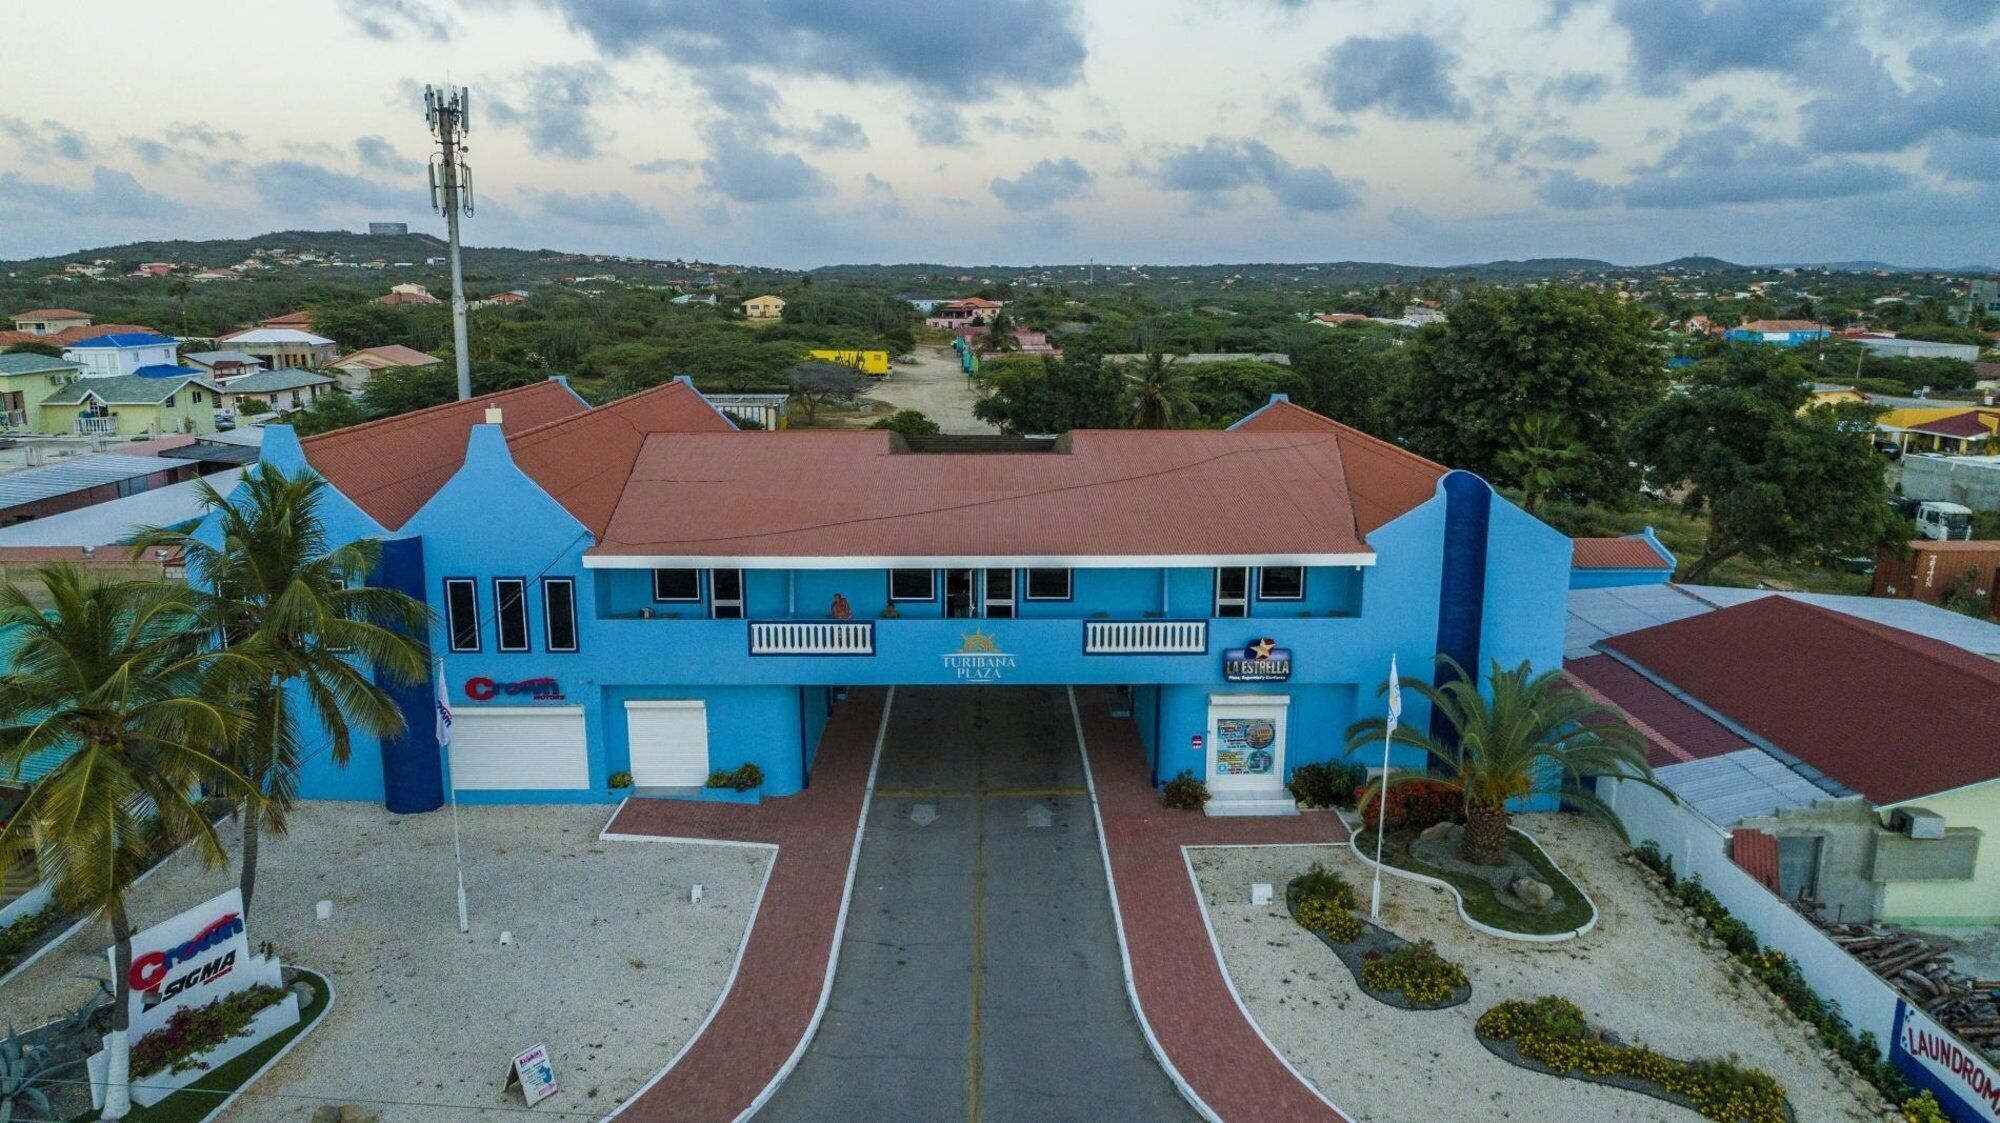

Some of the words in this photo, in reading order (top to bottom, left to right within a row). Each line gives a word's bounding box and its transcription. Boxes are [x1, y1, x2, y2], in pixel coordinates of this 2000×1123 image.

[943, 657, 1016, 668] TURIBANA
[957, 668, 1001, 679] PLAZA
[1226, 661, 1239, 675] LA
[1241, 660, 1289, 675] ESTRELLA
[465, 677, 560, 700] Crown
[129, 912, 244, 991] Crown
[161, 950, 237, 1003] SIGMA
[1908, 1027, 2000, 1117] LAUNDROM
